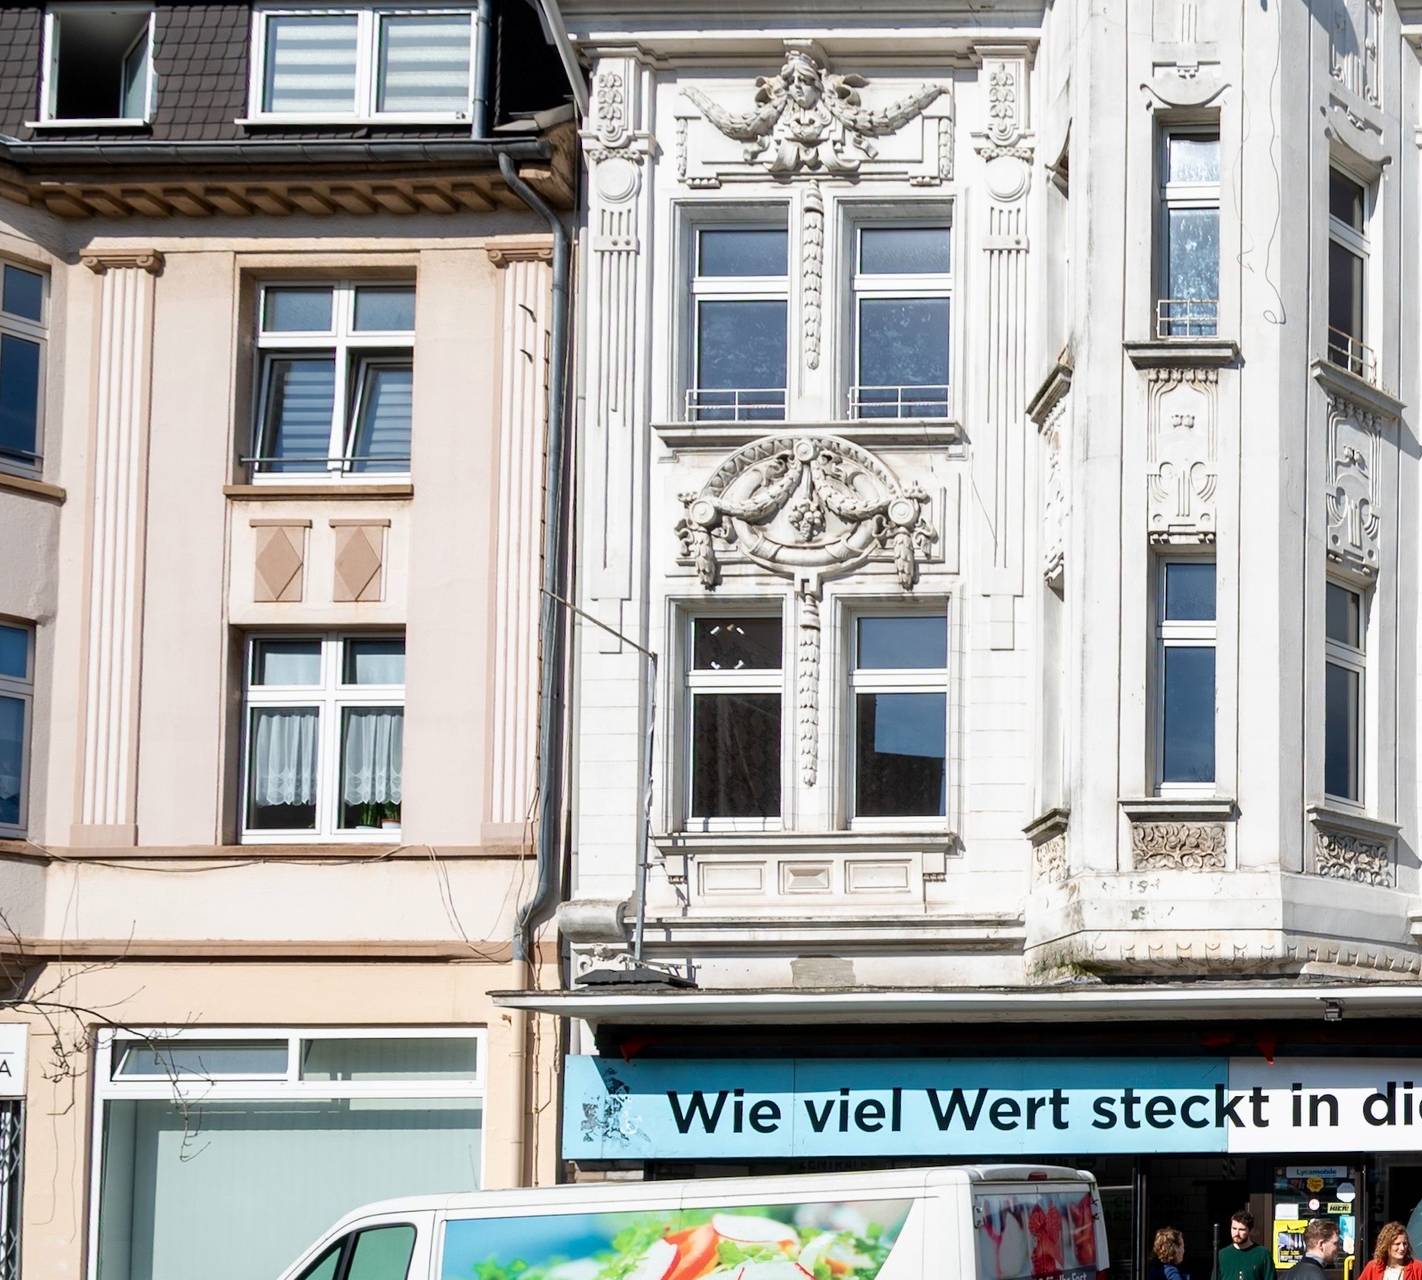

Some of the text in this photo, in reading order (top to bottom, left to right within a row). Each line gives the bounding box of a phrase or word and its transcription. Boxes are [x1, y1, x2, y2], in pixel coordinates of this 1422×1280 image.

[666, 1088, 781, 1132] Wie
[804, 1087, 902, 1131] viel
[926, 1087, 1069, 1130] Wert
[1092, 1082, 1269, 1128] steckt
[1292, 1081, 1338, 1126] in
